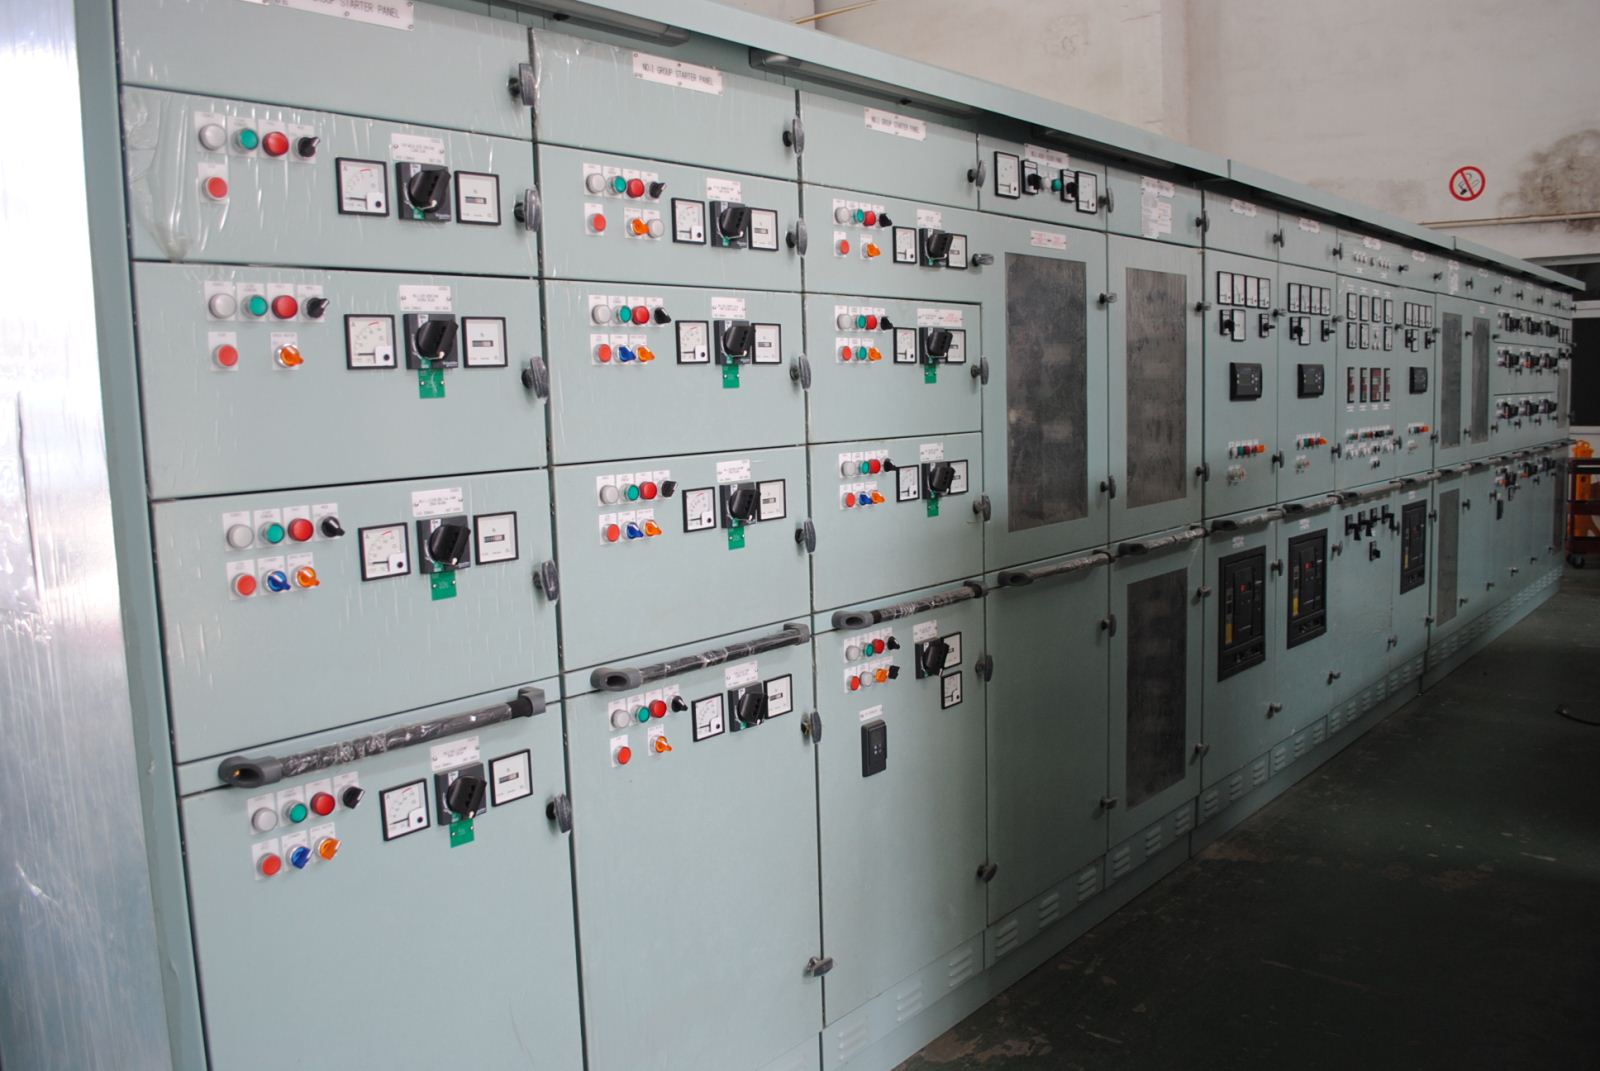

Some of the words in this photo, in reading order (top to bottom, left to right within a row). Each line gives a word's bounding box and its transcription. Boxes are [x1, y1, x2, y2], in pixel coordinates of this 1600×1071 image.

[340, 0, 373, 12] STARTER
[378, 5, 400, 18] PANEL
[675, 70, 697, 81] STARTER
[699, 75, 713, 86] PANEL
